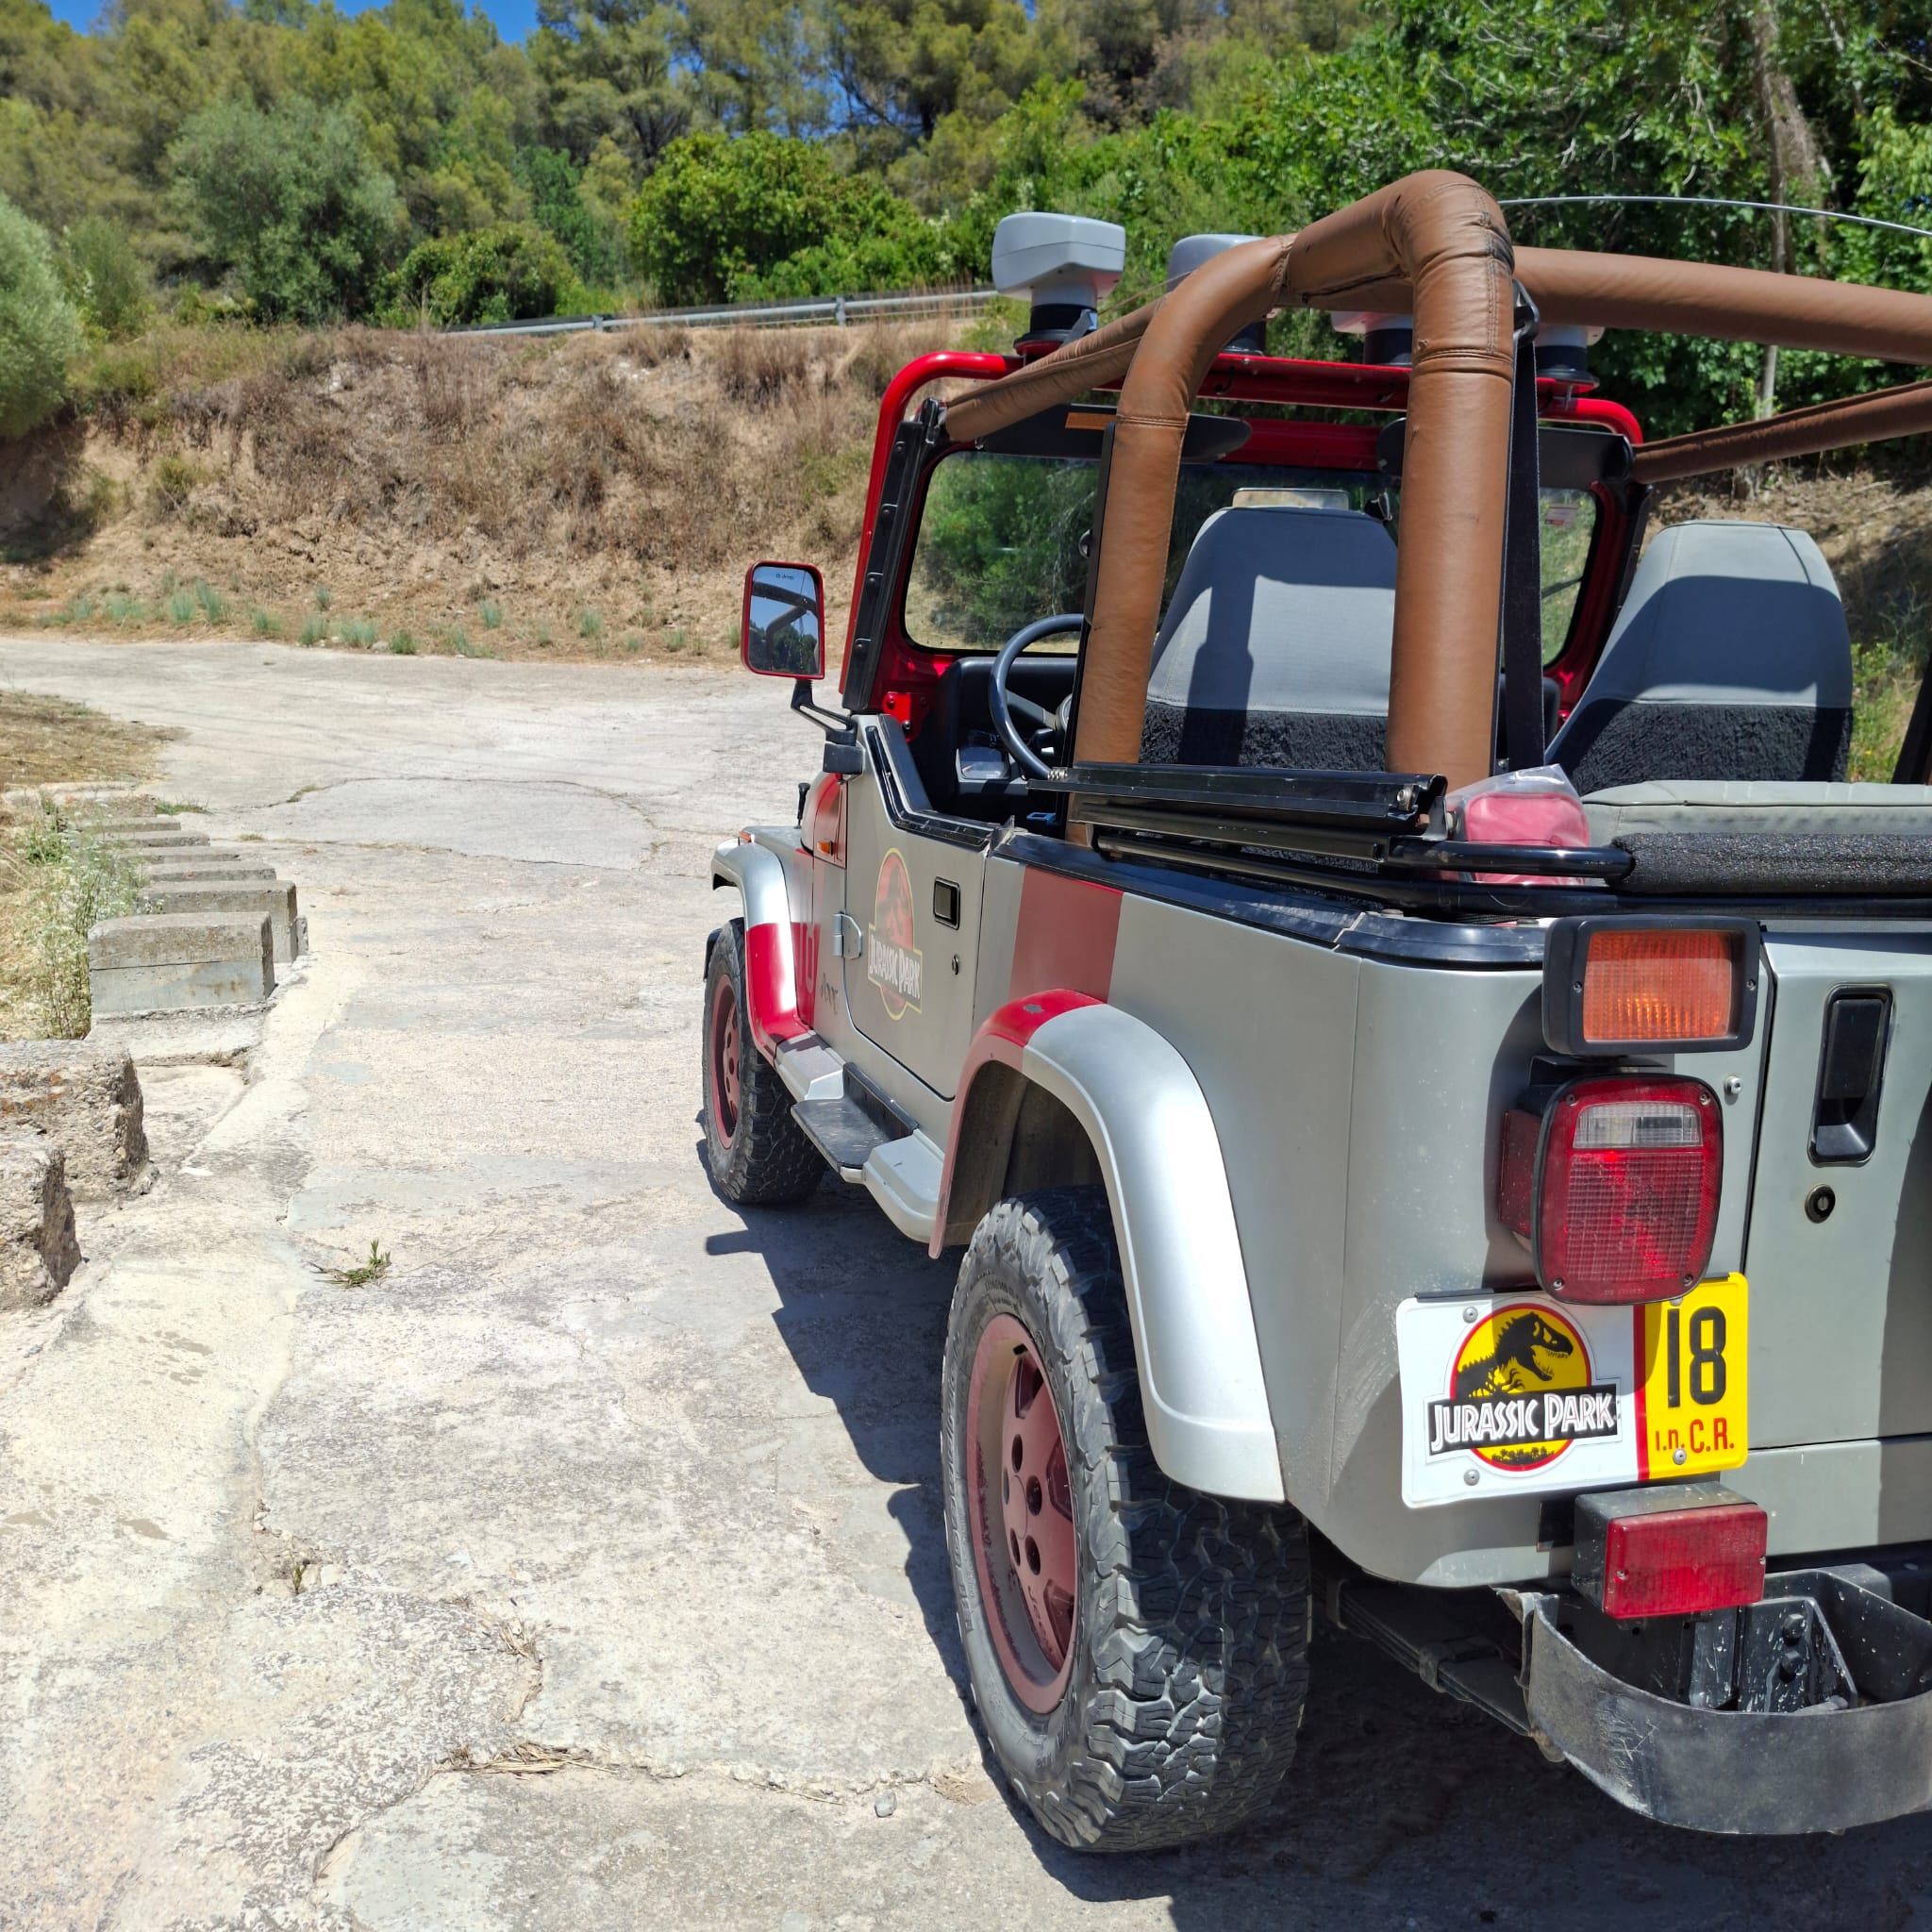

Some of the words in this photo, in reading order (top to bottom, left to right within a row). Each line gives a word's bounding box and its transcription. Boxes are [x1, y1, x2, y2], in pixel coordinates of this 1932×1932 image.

[869, 934, 898, 988] JURASSIC
[898, 948, 921, 1000] PARK
[1667, 1306, 1726, 1408] 18
[1430, 1399, 1540, 1454] JURASSIC
[1543, 1391, 1616, 1440] PARK
